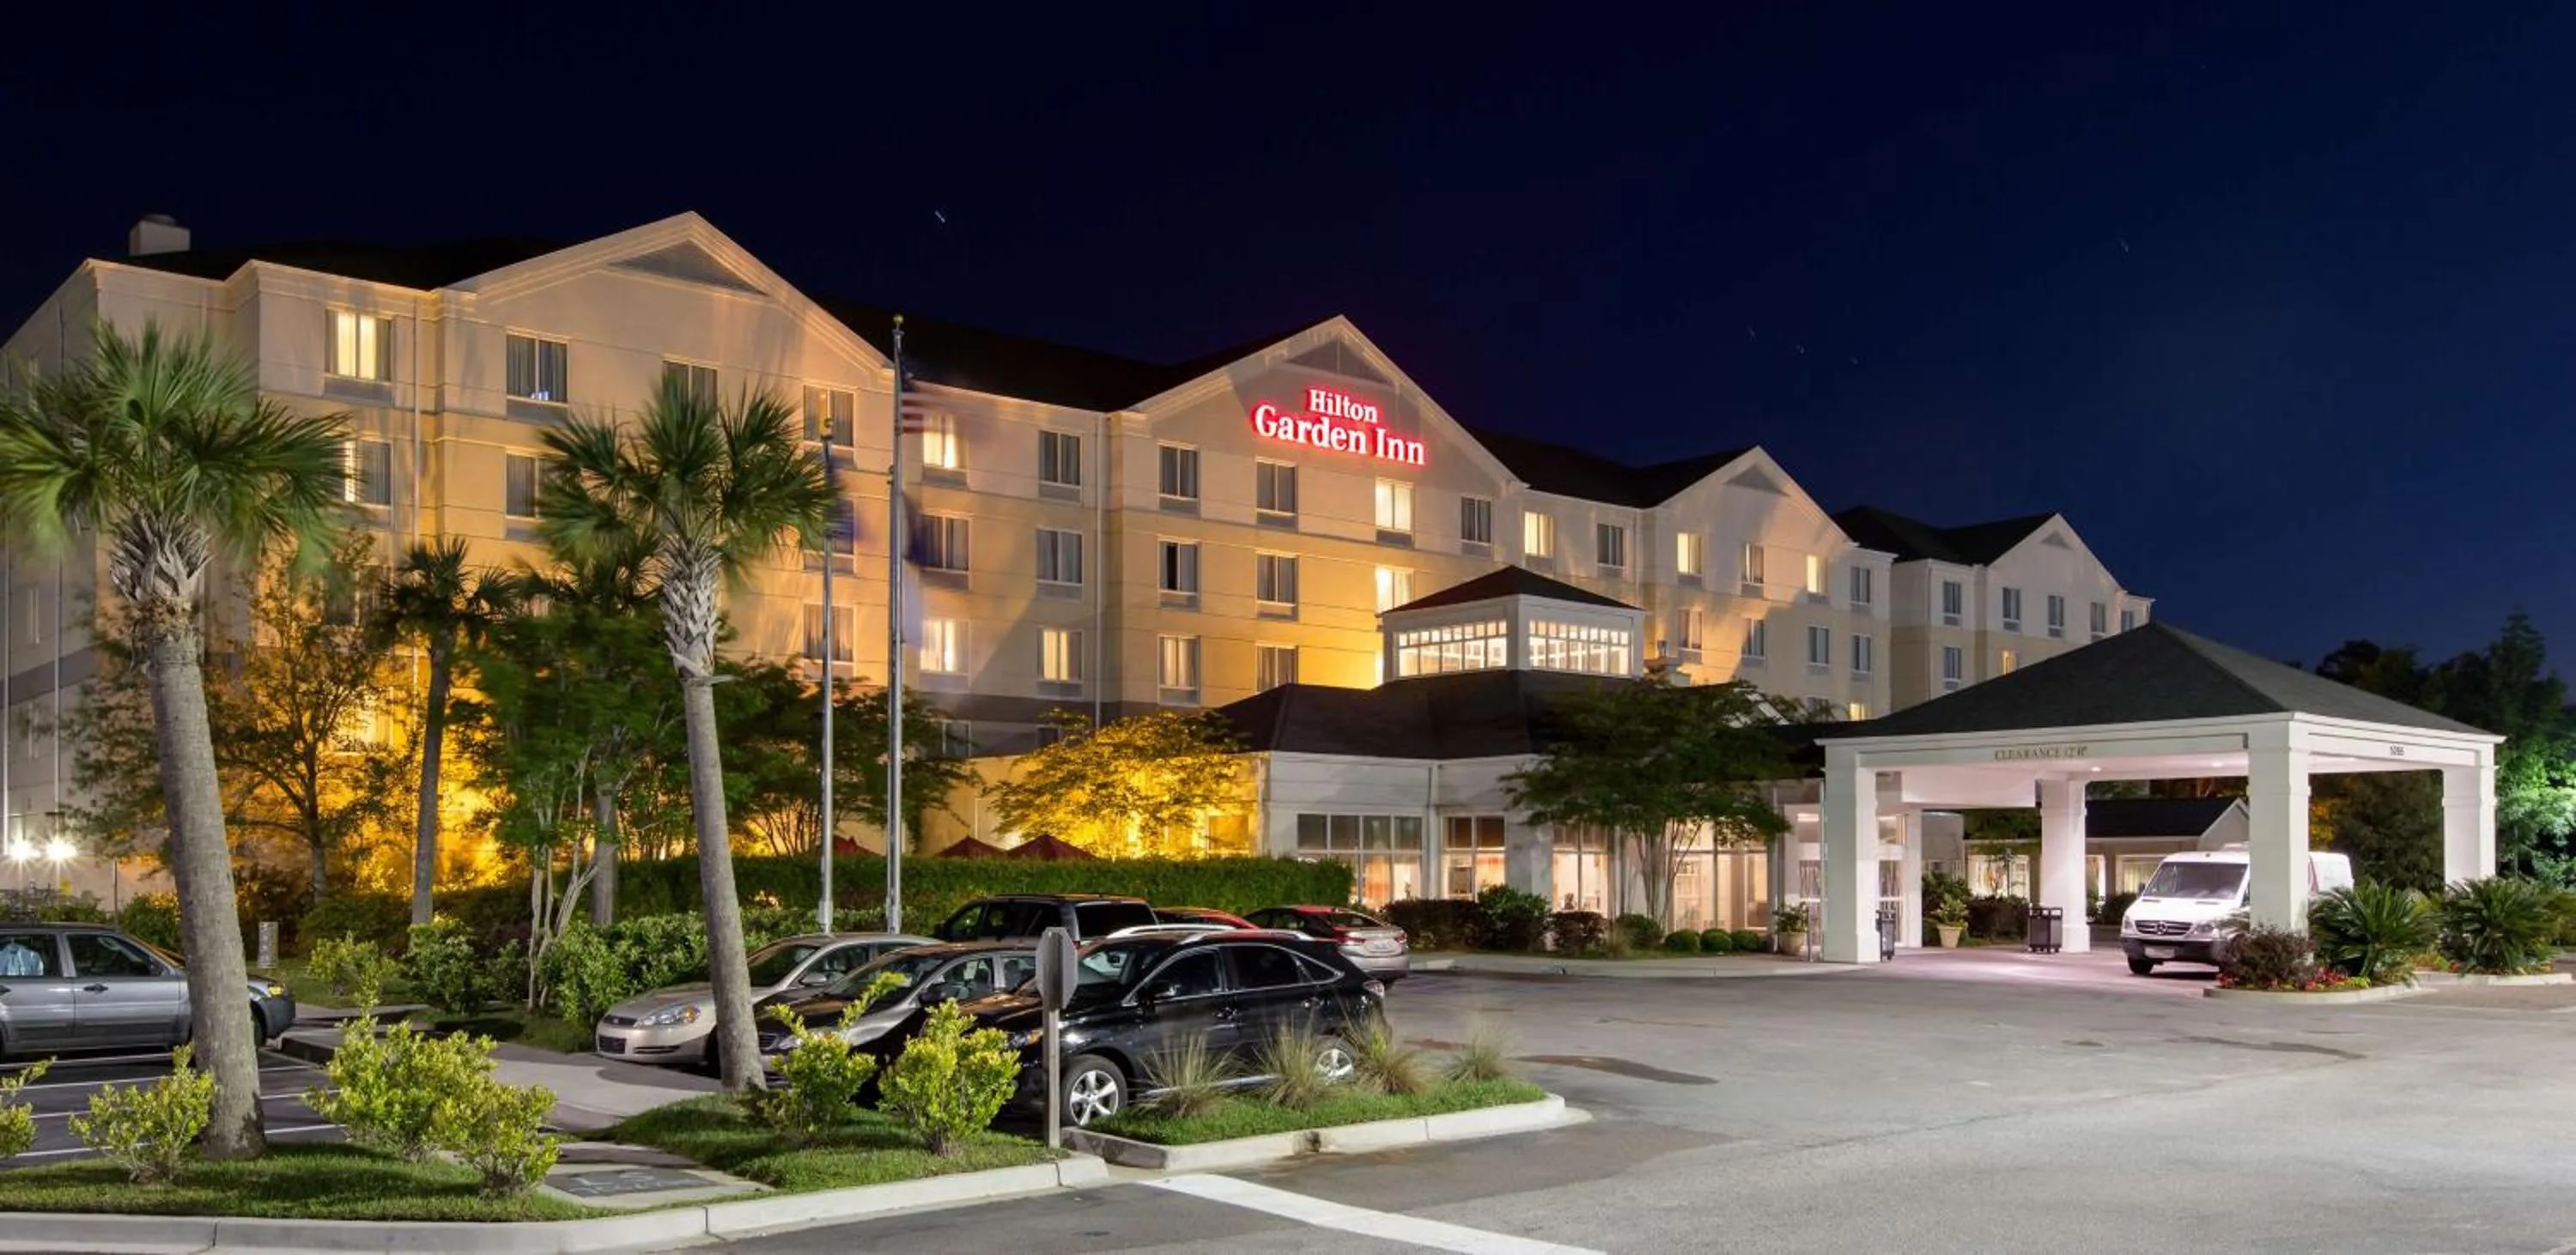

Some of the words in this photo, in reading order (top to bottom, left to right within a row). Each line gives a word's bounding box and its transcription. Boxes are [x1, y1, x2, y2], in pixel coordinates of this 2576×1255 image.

[1309, 389, 1378, 424] Hilton
[1255, 404, 1367, 454] Garden
[1376, 427, 1425, 465] Inn
